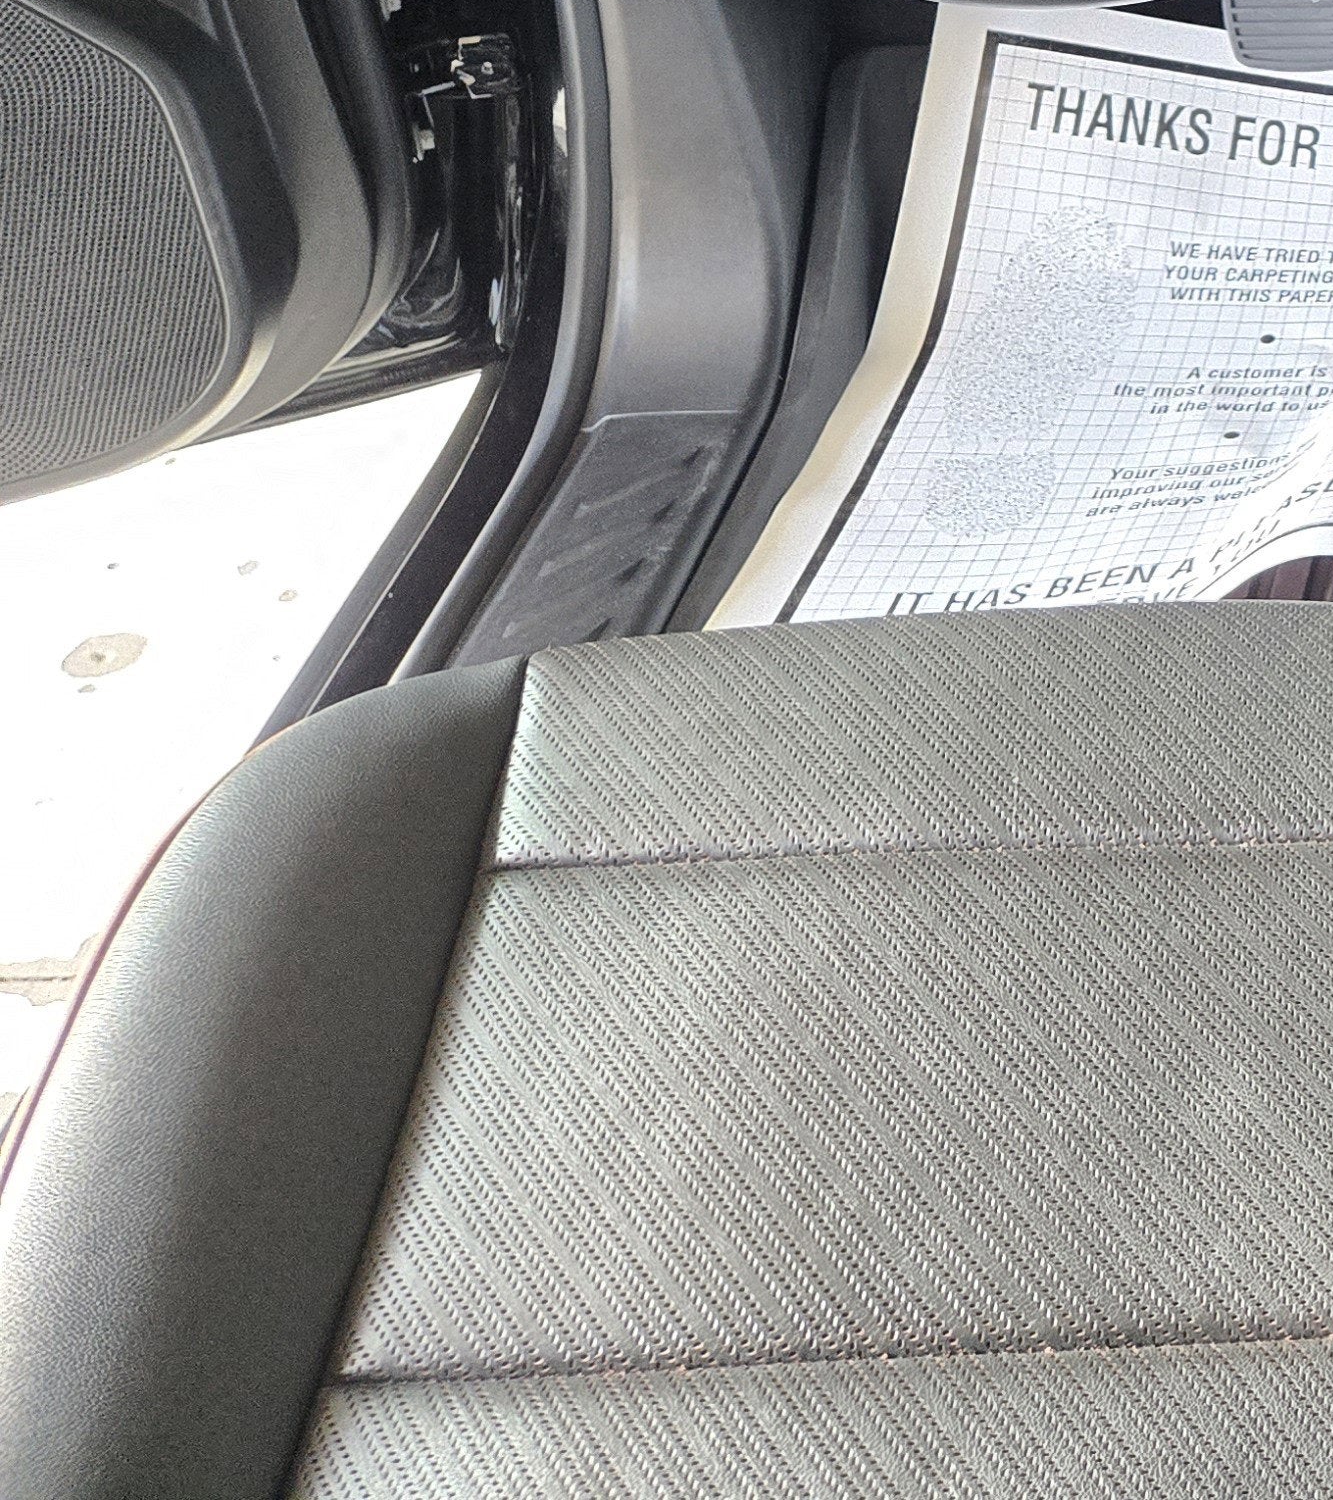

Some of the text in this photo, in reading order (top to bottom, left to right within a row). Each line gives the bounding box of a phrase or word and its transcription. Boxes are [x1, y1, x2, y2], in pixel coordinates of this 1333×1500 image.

[1027, 81, 1213, 155] THANKS
[1228, 114, 1320, 170] FOR
[1169, 240, 1201, 258] WE
[1206, 244, 1259, 262] HAVE
[1264, 247, 1321, 264] TRIED
[1164, 264, 1218, 282] YOUR
[1170, 287, 1221, 302] WITH
[1227, 287, 1271, 303] THIS
[1186, 365, 1328, 379] A customer is
[1113, 383, 1146, 397] the
[1152, 384, 1205, 399] most
[1211, 383, 1312, 401] important
[1150, 402, 1168, 415] in
[1176, 400, 1208, 413] the
[1216, 400, 1276, 413] world
[1280, 401, 1300, 412] to
[1110, 467, 1159, 481] Your
[1091, 478, 1205, 500] improving
[1208, 475, 1249, 488] our
[1086, 494, 1204, 517] are always
[885, 590, 935, 616] IT
[943, 581, 1032, 615] HAS
[1044, 562, 1160, 600] BEEN
[1167, 556, 1197, 580] A
